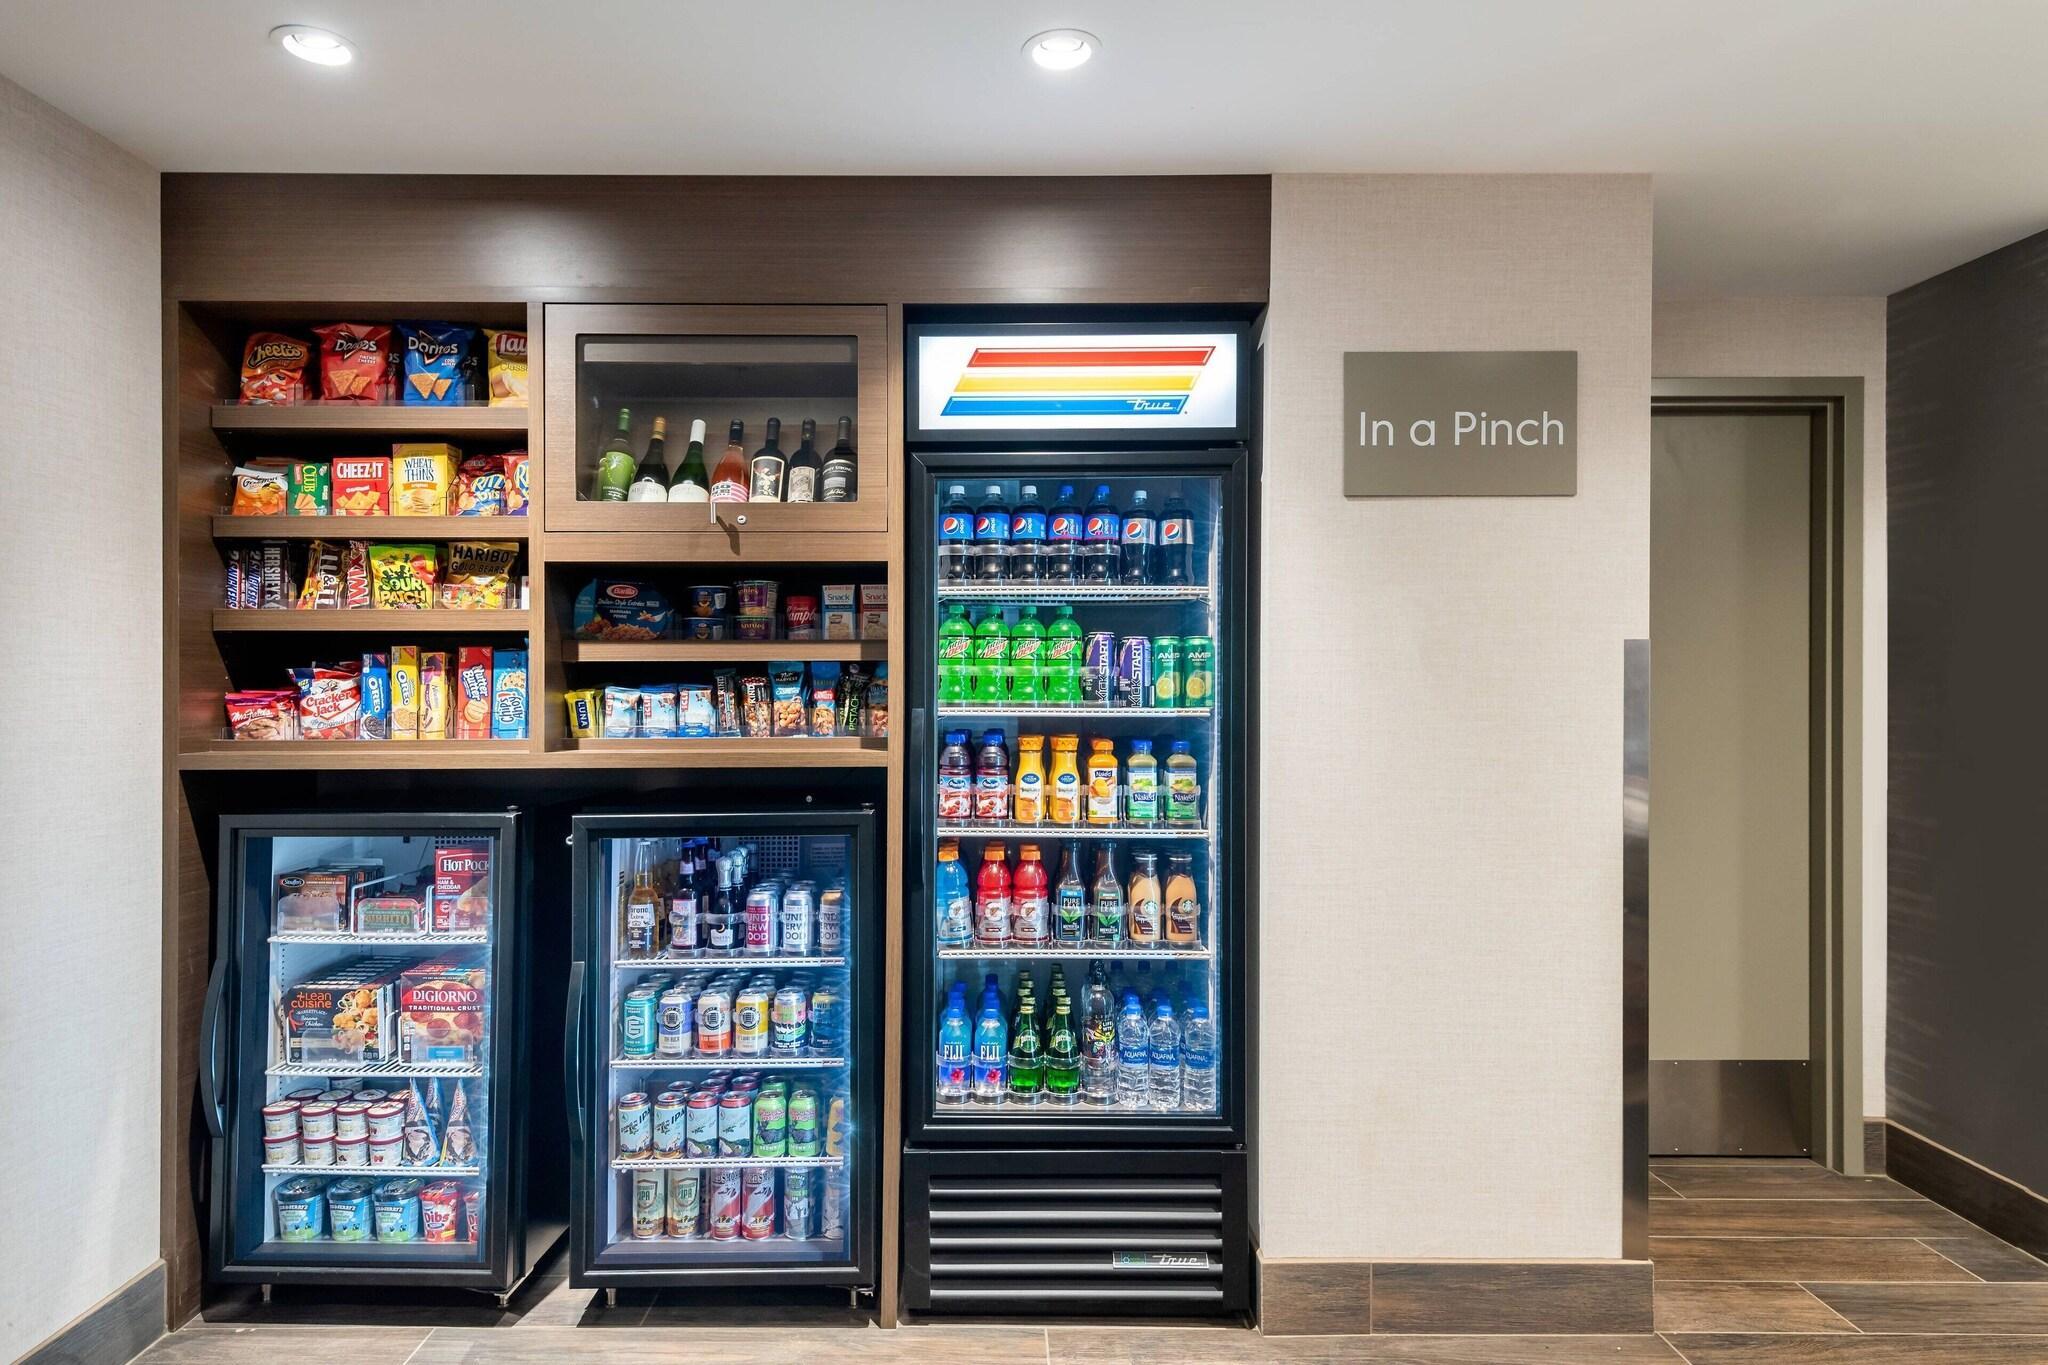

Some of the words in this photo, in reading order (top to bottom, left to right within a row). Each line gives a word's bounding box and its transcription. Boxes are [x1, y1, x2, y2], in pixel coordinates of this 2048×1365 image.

[336, 340, 377, 352] Doritos
[408, 336, 458, 354] Doritos
[247, 342, 303, 368] Cheetos
[1126, 398, 1174, 411] true
[1360, 411, 1394, 446] In
[1409, 419, 1436, 446] a
[1454, 411, 1564, 446] Pinch
[404, 458, 433, 469] WHEAT
[302, 464, 317, 493] CLUB
[471, 474, 505, 489] RITZ
[453, 545, 510, 563] HARIBO
[264, 547, 281, 601] HERSHEY'S
[451, 561, 476, 572] GOLD
[479, 564, 505, 574] BEARS
[227, 560, 240, 609] SNICKERS
[246, 560, 260, 609] SNICKERS
[347, 555, 370, 609] TWIX
[381, 576, 423, 591] SOUR
[380, 590, 426, 604] PATCH
[612, 588, 636, 596] Barilla
[1096, 639, 1109, 703] KICKSTART
[1128, 643, 1142, 708] KICKSTART
[396, 669, 409, 706] OREO
[463, 670, 481, 702] Butter
[472, 663, 488, 698] Nutter
[718, 675, 726, 696] KIND
[306, 691, 352, 707] Cracker
[367, 676, 381, 713] OREO
[748, 683, 756, 706] KIND
[314, 703, 341, 717] Jack
[500, 698, 512, 724] Chips
[577, 701, 588, 727] LUNA
[1134, 793, 1157, 801] Naked
[1174, 793, 1195, 801] Naked
[443, 859, 464, 871] HOT
[748, 914, 769, 922] UND
[944, 1044, 964, 1060] FIJI
[980, 1045, 1000, 1060] FIJI
[1152, 1051, 1175, 1060] AQUAFINA
[424, 1210, 450, 1223] Dibs
[1152, 1254, 1204, 1265] true
